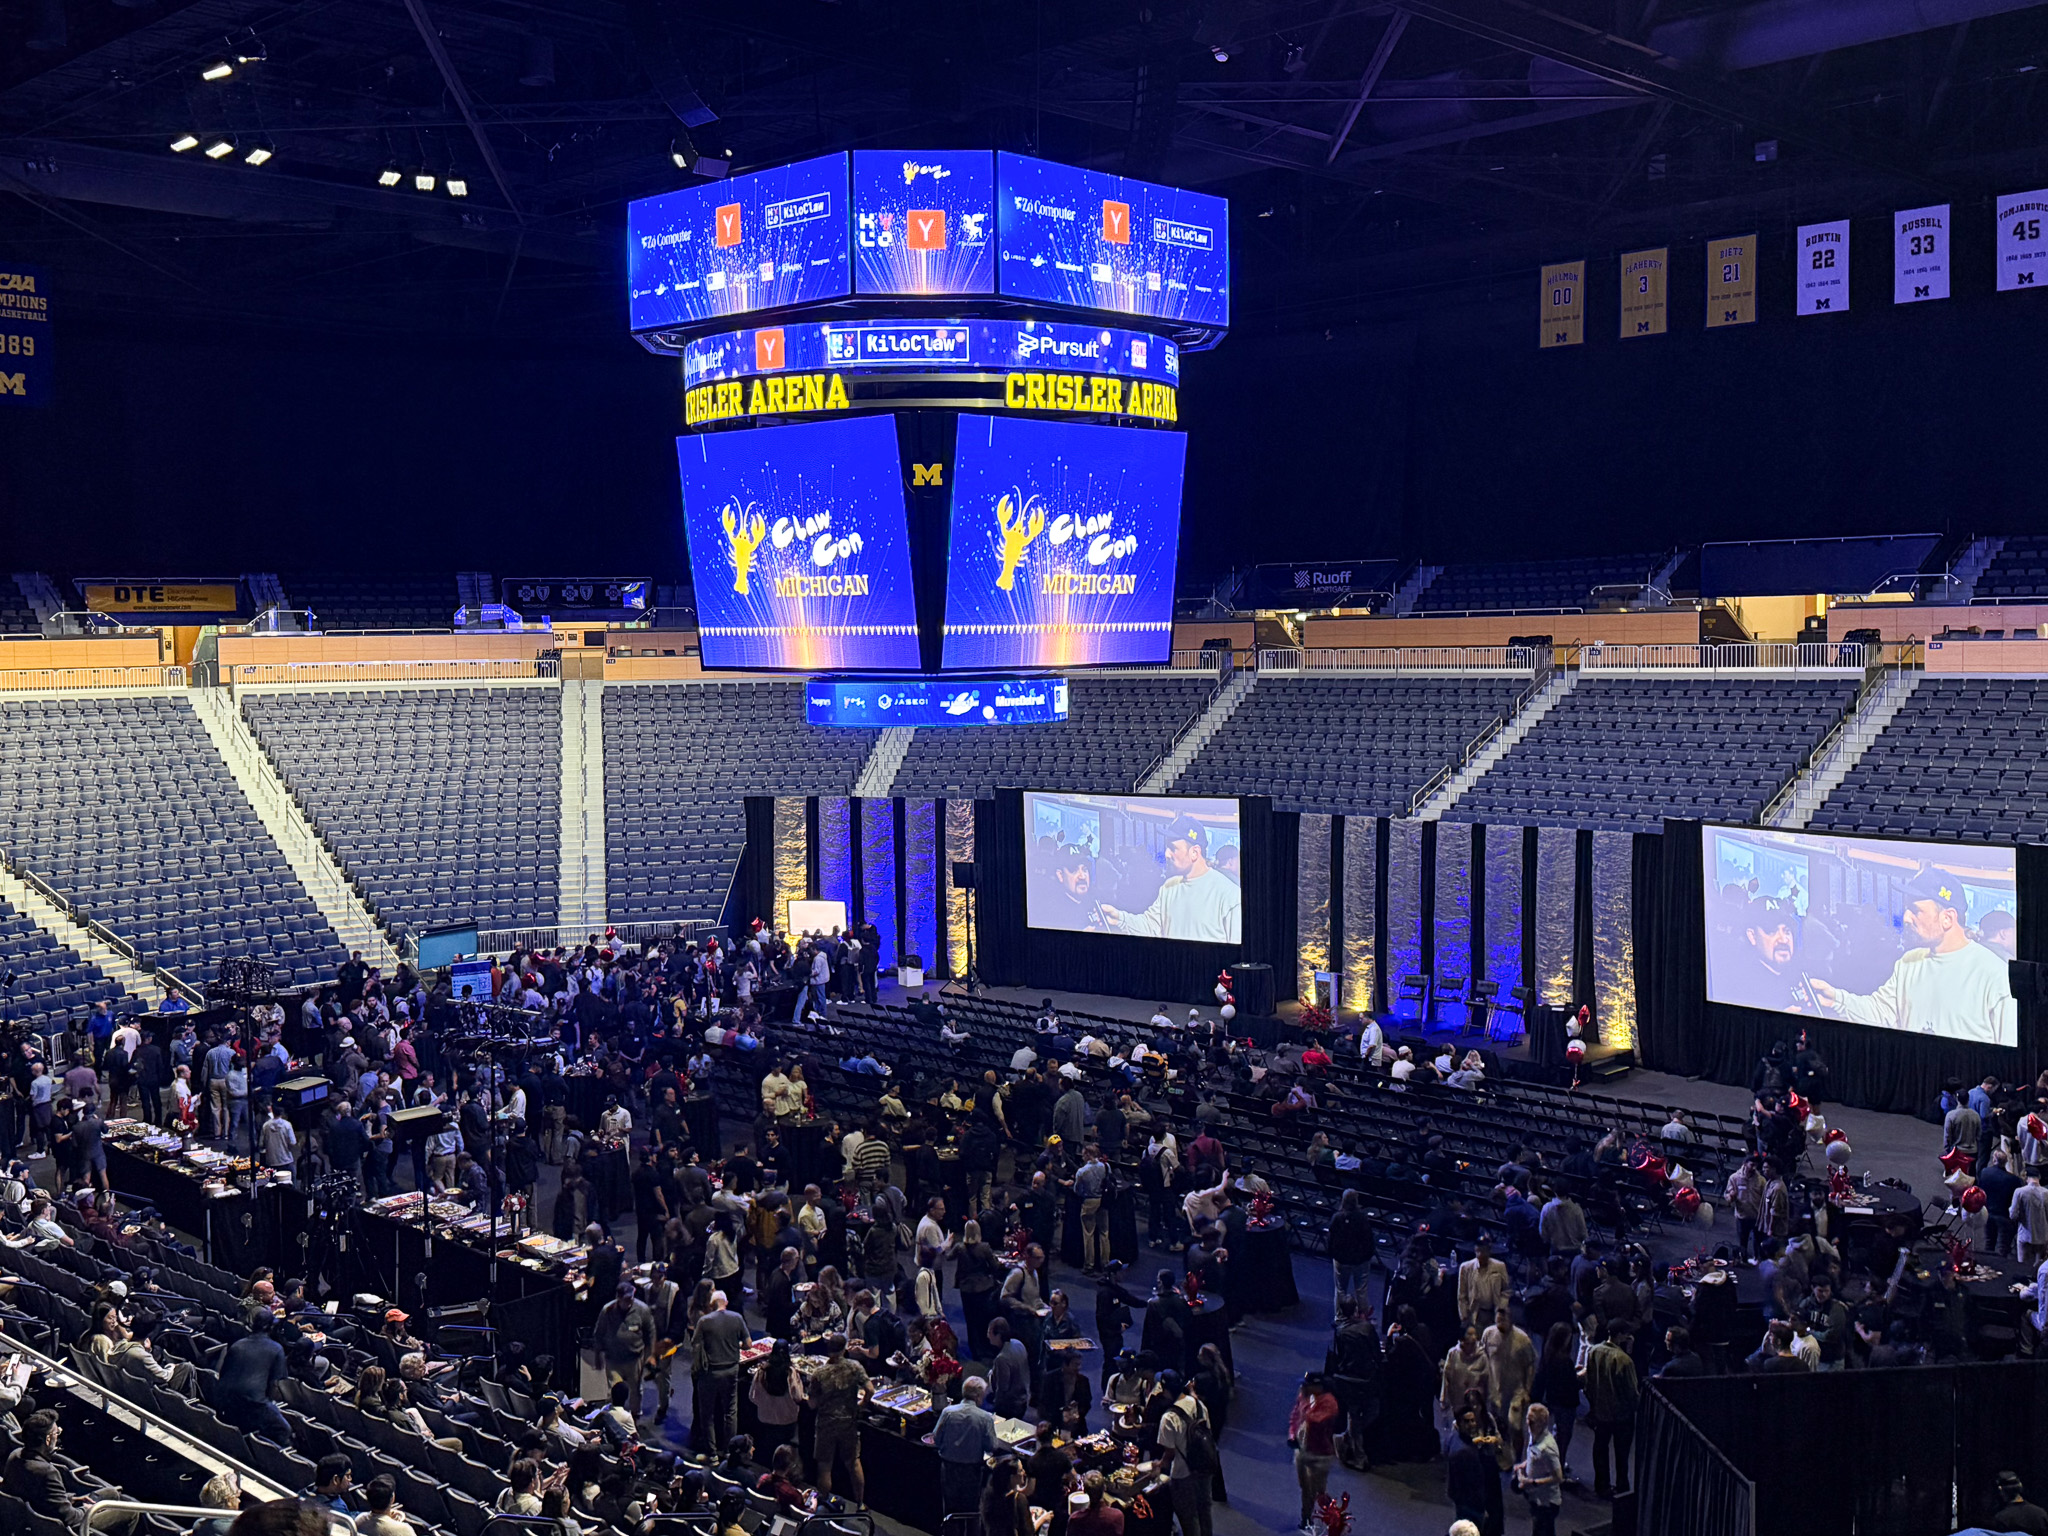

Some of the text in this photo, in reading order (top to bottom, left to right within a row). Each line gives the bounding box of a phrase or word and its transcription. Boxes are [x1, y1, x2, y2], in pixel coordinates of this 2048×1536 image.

[783, 200, 824, 219] KiloClaw
[1034, 200, 1076, 222] Computer
[722, 213, 734, 238] Y
[918, 218, 934, 242] Y
[1110, 210, 1123, 234] Y
[1901, 217, 1942, 234] RUSSELL
[2012, 219, 2040, 241] 45
[657, 230, 692, 248] Computer
[1170, 227, 1208, 244] KiloClaw
[1805, 232, 1841, 248] BUNTIN
[1911, 235, 1935, 255] 33
[1720, 247, 1743, 259] DIETZ
[1812, 249, 1835, 270] 22
[1625, 259, 1662, 277] FLAHERTY
[1723, 263, 1740, 282] 21
[1547, 272, 1579, 286] HILLMON
[1639, 276, 1648, 293] 3
[2017, 272, 2035, 284] M
[1553, 287, 1571, 306] 00
[1914, 285, 1930, 297] M
[1815, 298, 1830, 310] M
[1725, 310, 1737, 321] M
[1637, 321, 1649, 332] M
[866, 334, 956, 352] KiloClaw
[1555, 332, 1567, 343] M
[763, 338, 776, 361] Y
[1040, 337, 1100, 358] Pursuit
[0, 371, 27, 396] M
[685, 373, 850, 425] CRISLER ARENA
[1006, 372, 1178, 421] CRISLER ARENA
[912, 463, 943, 486] M
[812, 532, 864, 567] Con
[1088, 533, 1138, 566] Con
[774, 574, 869, 598] MICHIGAN
[1041, 574, 1137, 595] MICHIGAN
[1312, 570, 1352, 585] Ruoff
[114, 586, 164, 603] DTE
[1313, 585, 1352, 594] MORTGAGE
